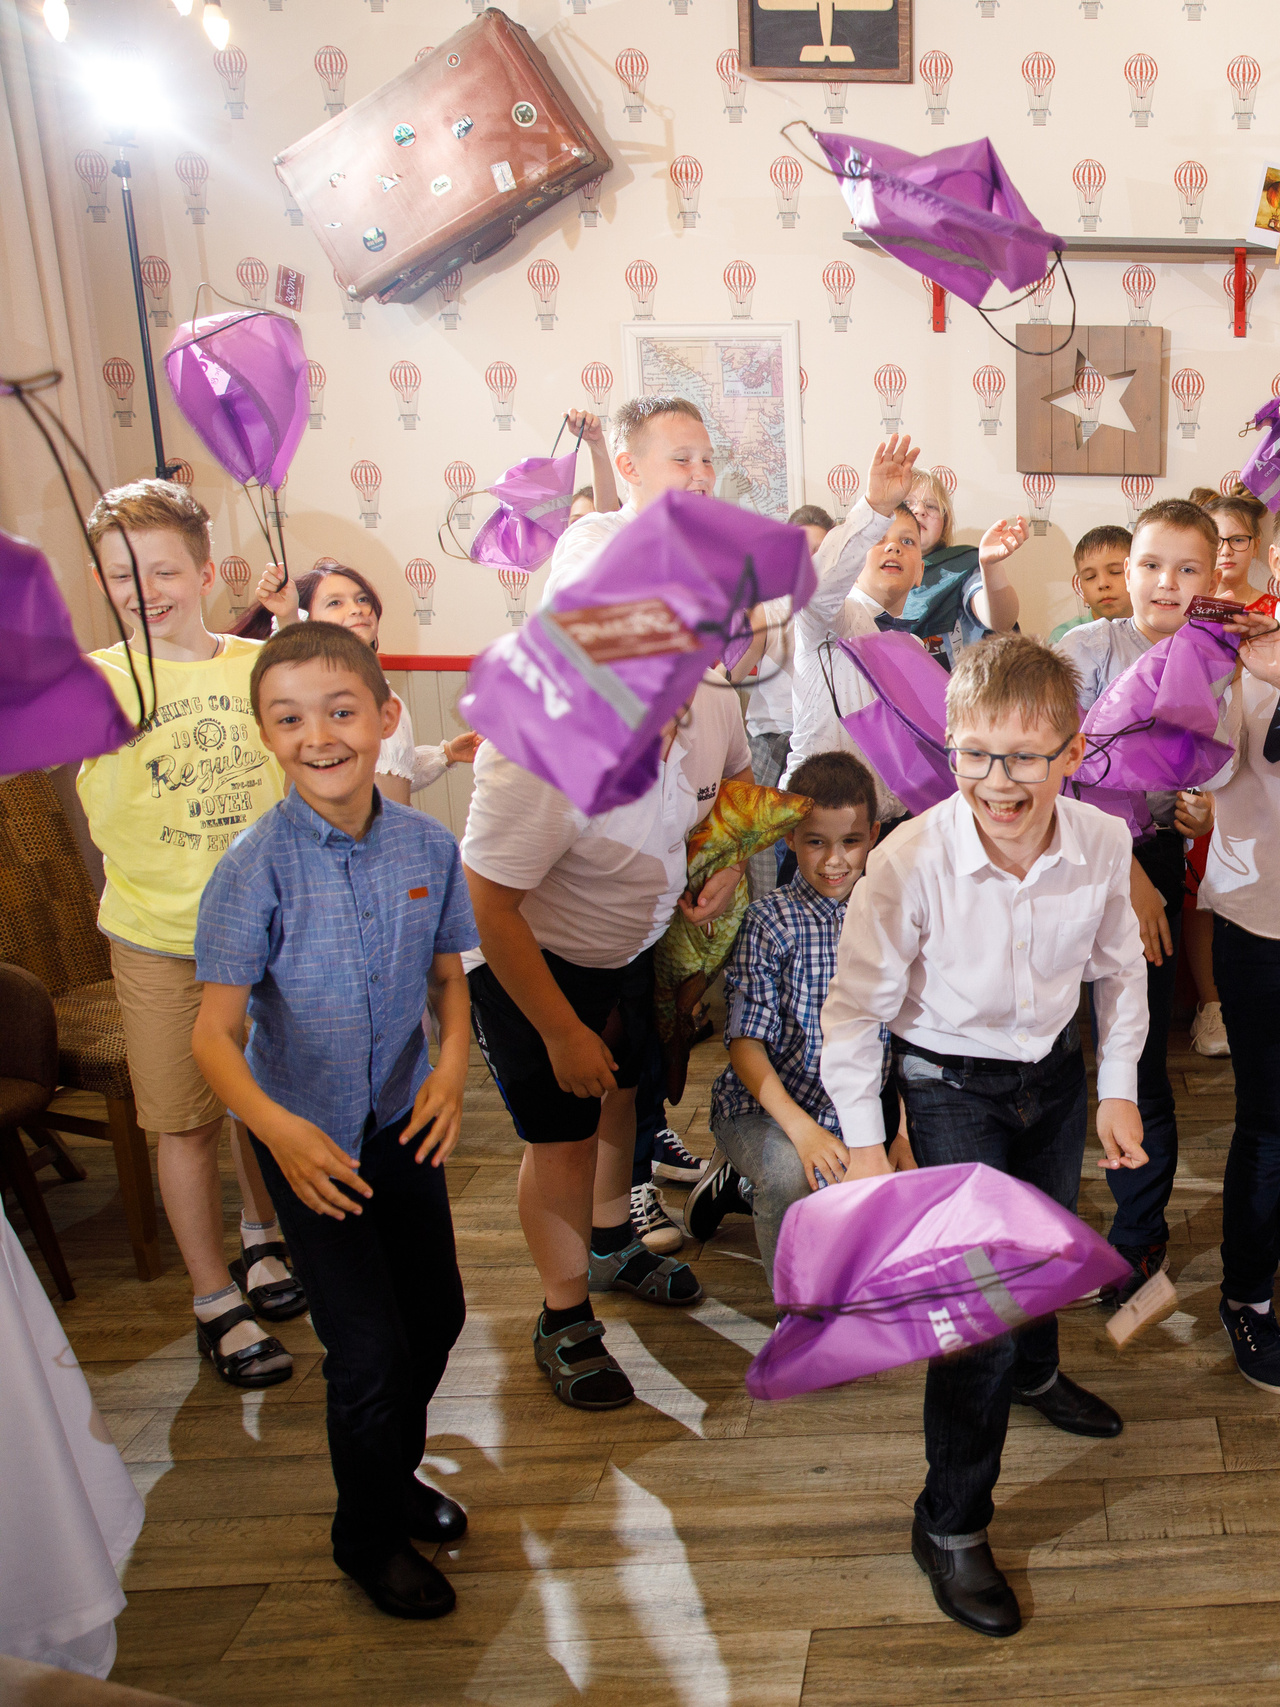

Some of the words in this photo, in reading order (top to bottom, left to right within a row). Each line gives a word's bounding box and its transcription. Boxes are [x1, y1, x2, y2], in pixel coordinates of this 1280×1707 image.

[171, 730, 192, 750] 19
[229, 723, 249, 743] 86
[145, 745, 269, 799] Regular
[186, 790, 254, 819] DOVER
[200, 814, 248, 830] DELAWARE
[160, 825, 202, 851] NEW
